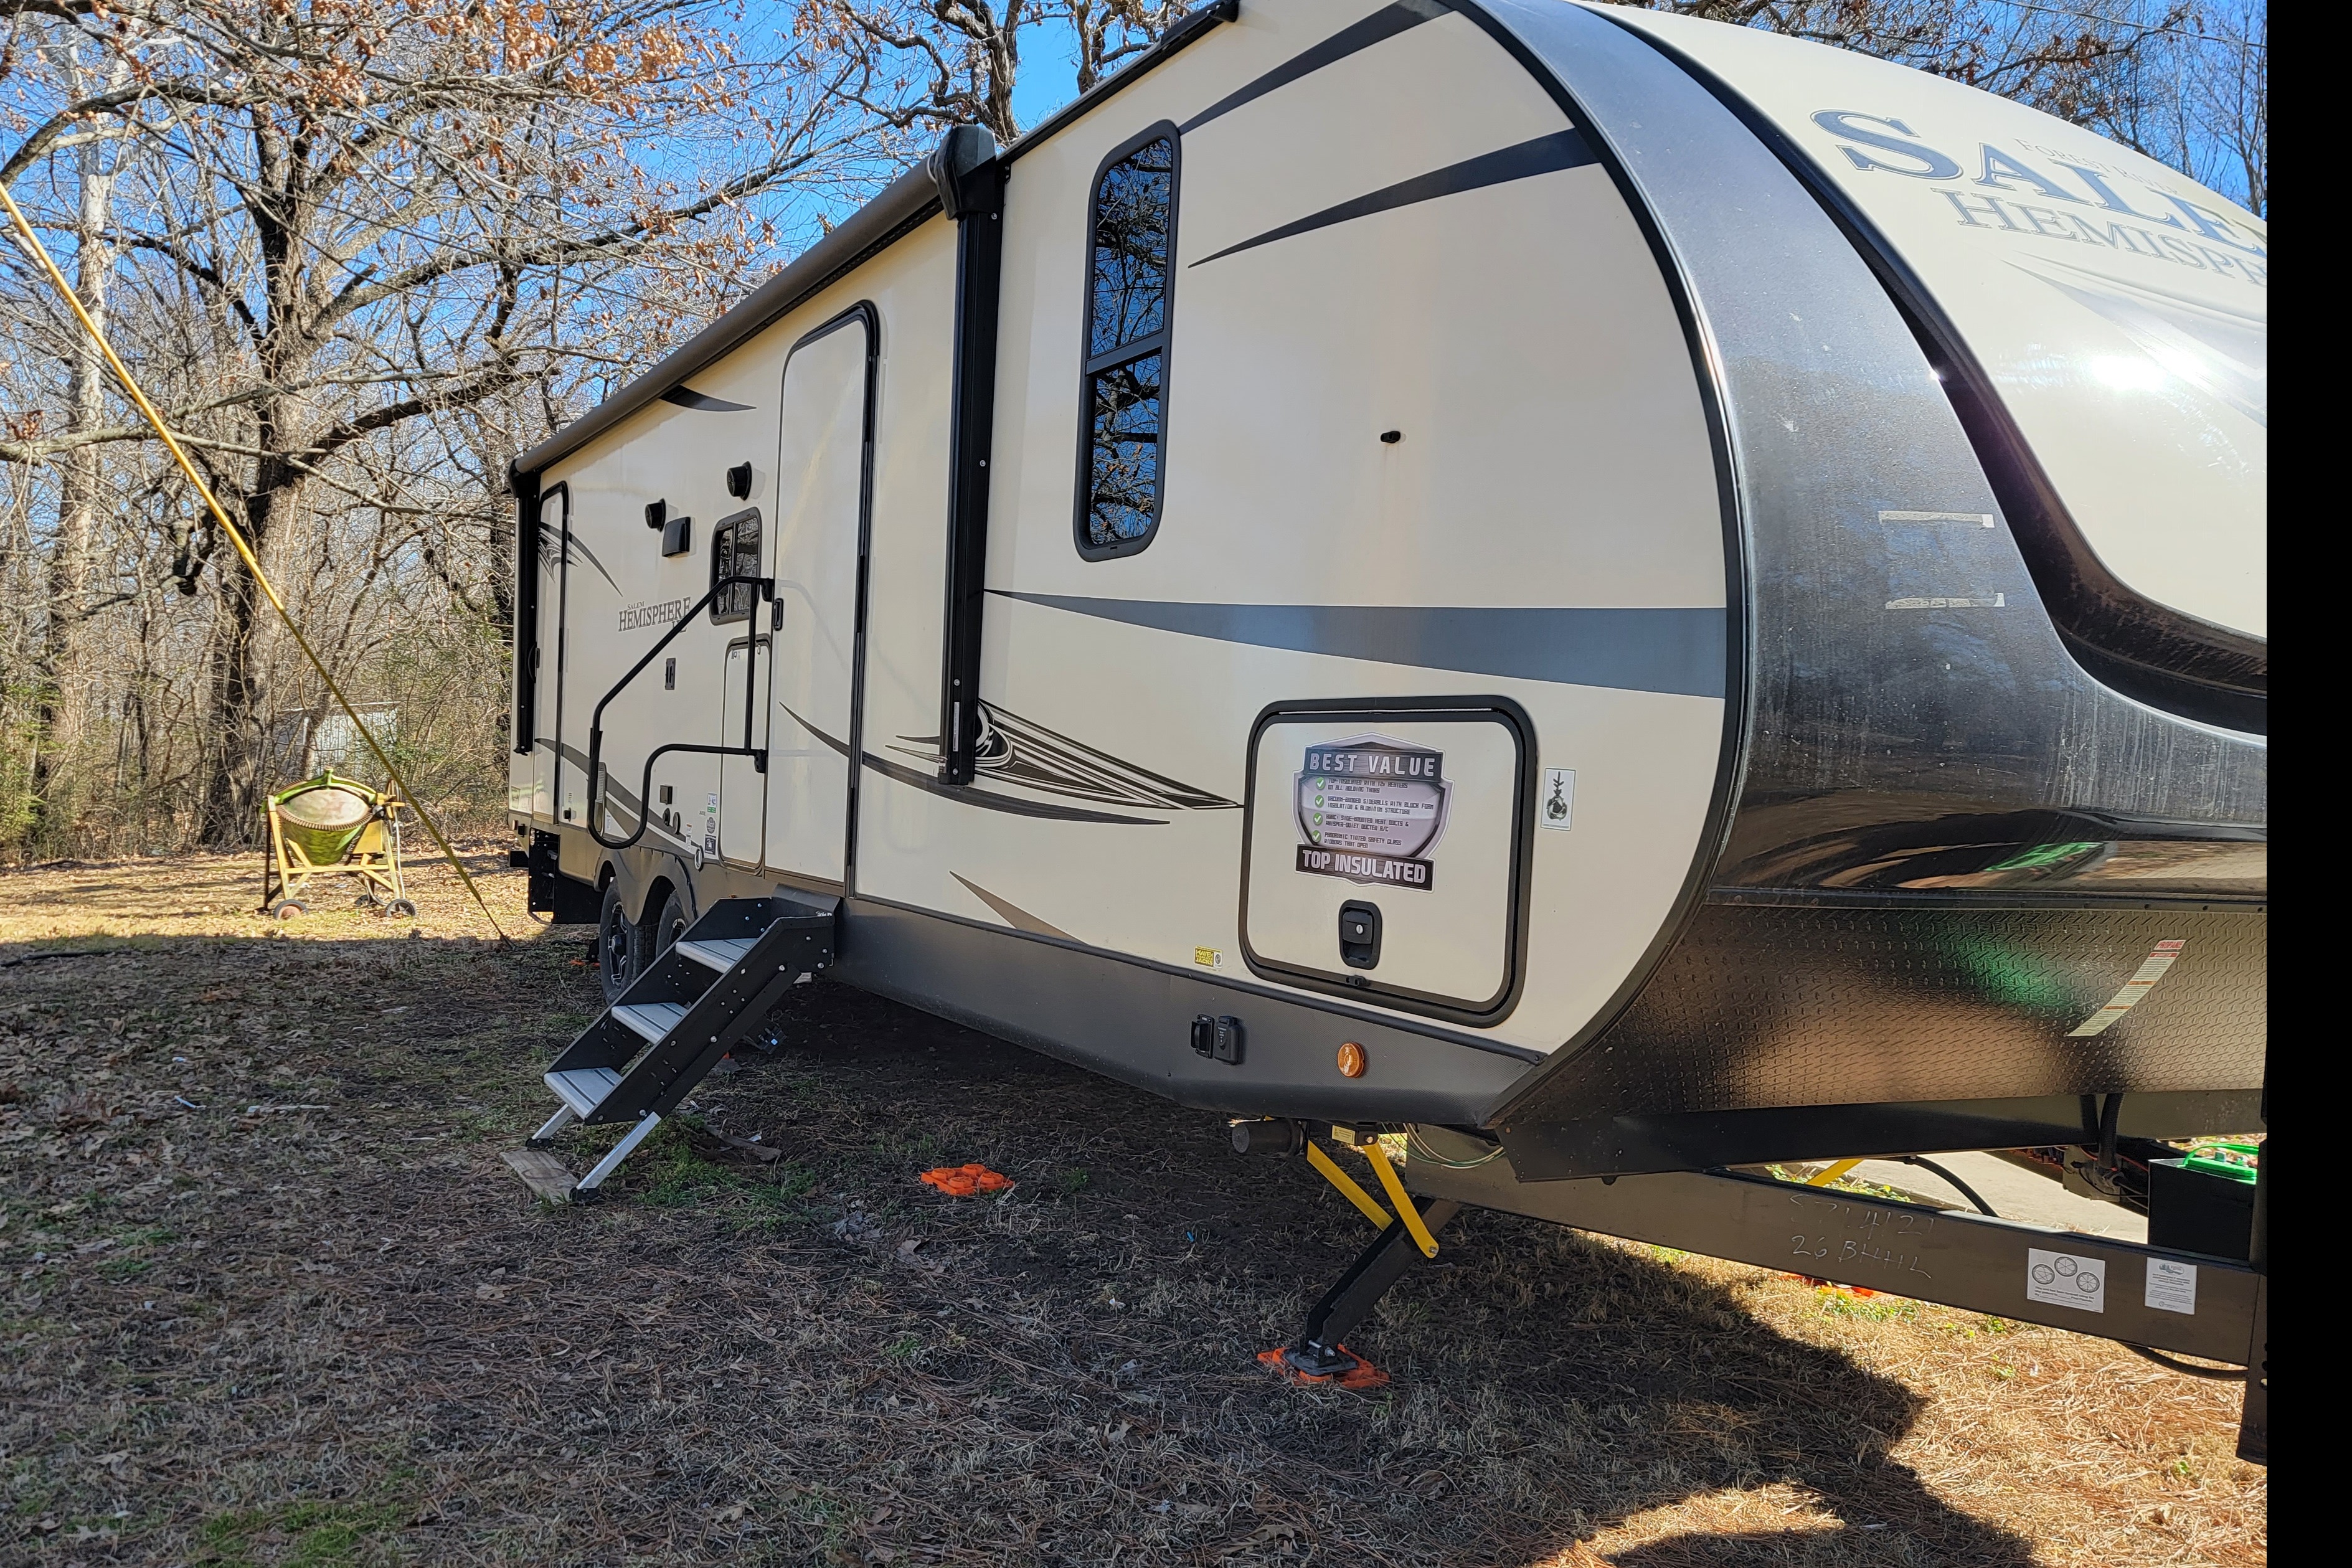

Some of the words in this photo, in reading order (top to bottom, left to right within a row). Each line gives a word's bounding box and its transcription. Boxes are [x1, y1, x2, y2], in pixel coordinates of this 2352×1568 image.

[1810, 108, 2266, 259] SALE
[618, 597, 691, 631] HEMISPHERE
[627, 601, 645, 610] SALEM
[1310, 753, 1358, 772] BEST
[1368, 755, 1435, 777] VALUE
[1302, 849, 1331, 870] TOP
[1334, 854, 1426, 884] INSULATED
